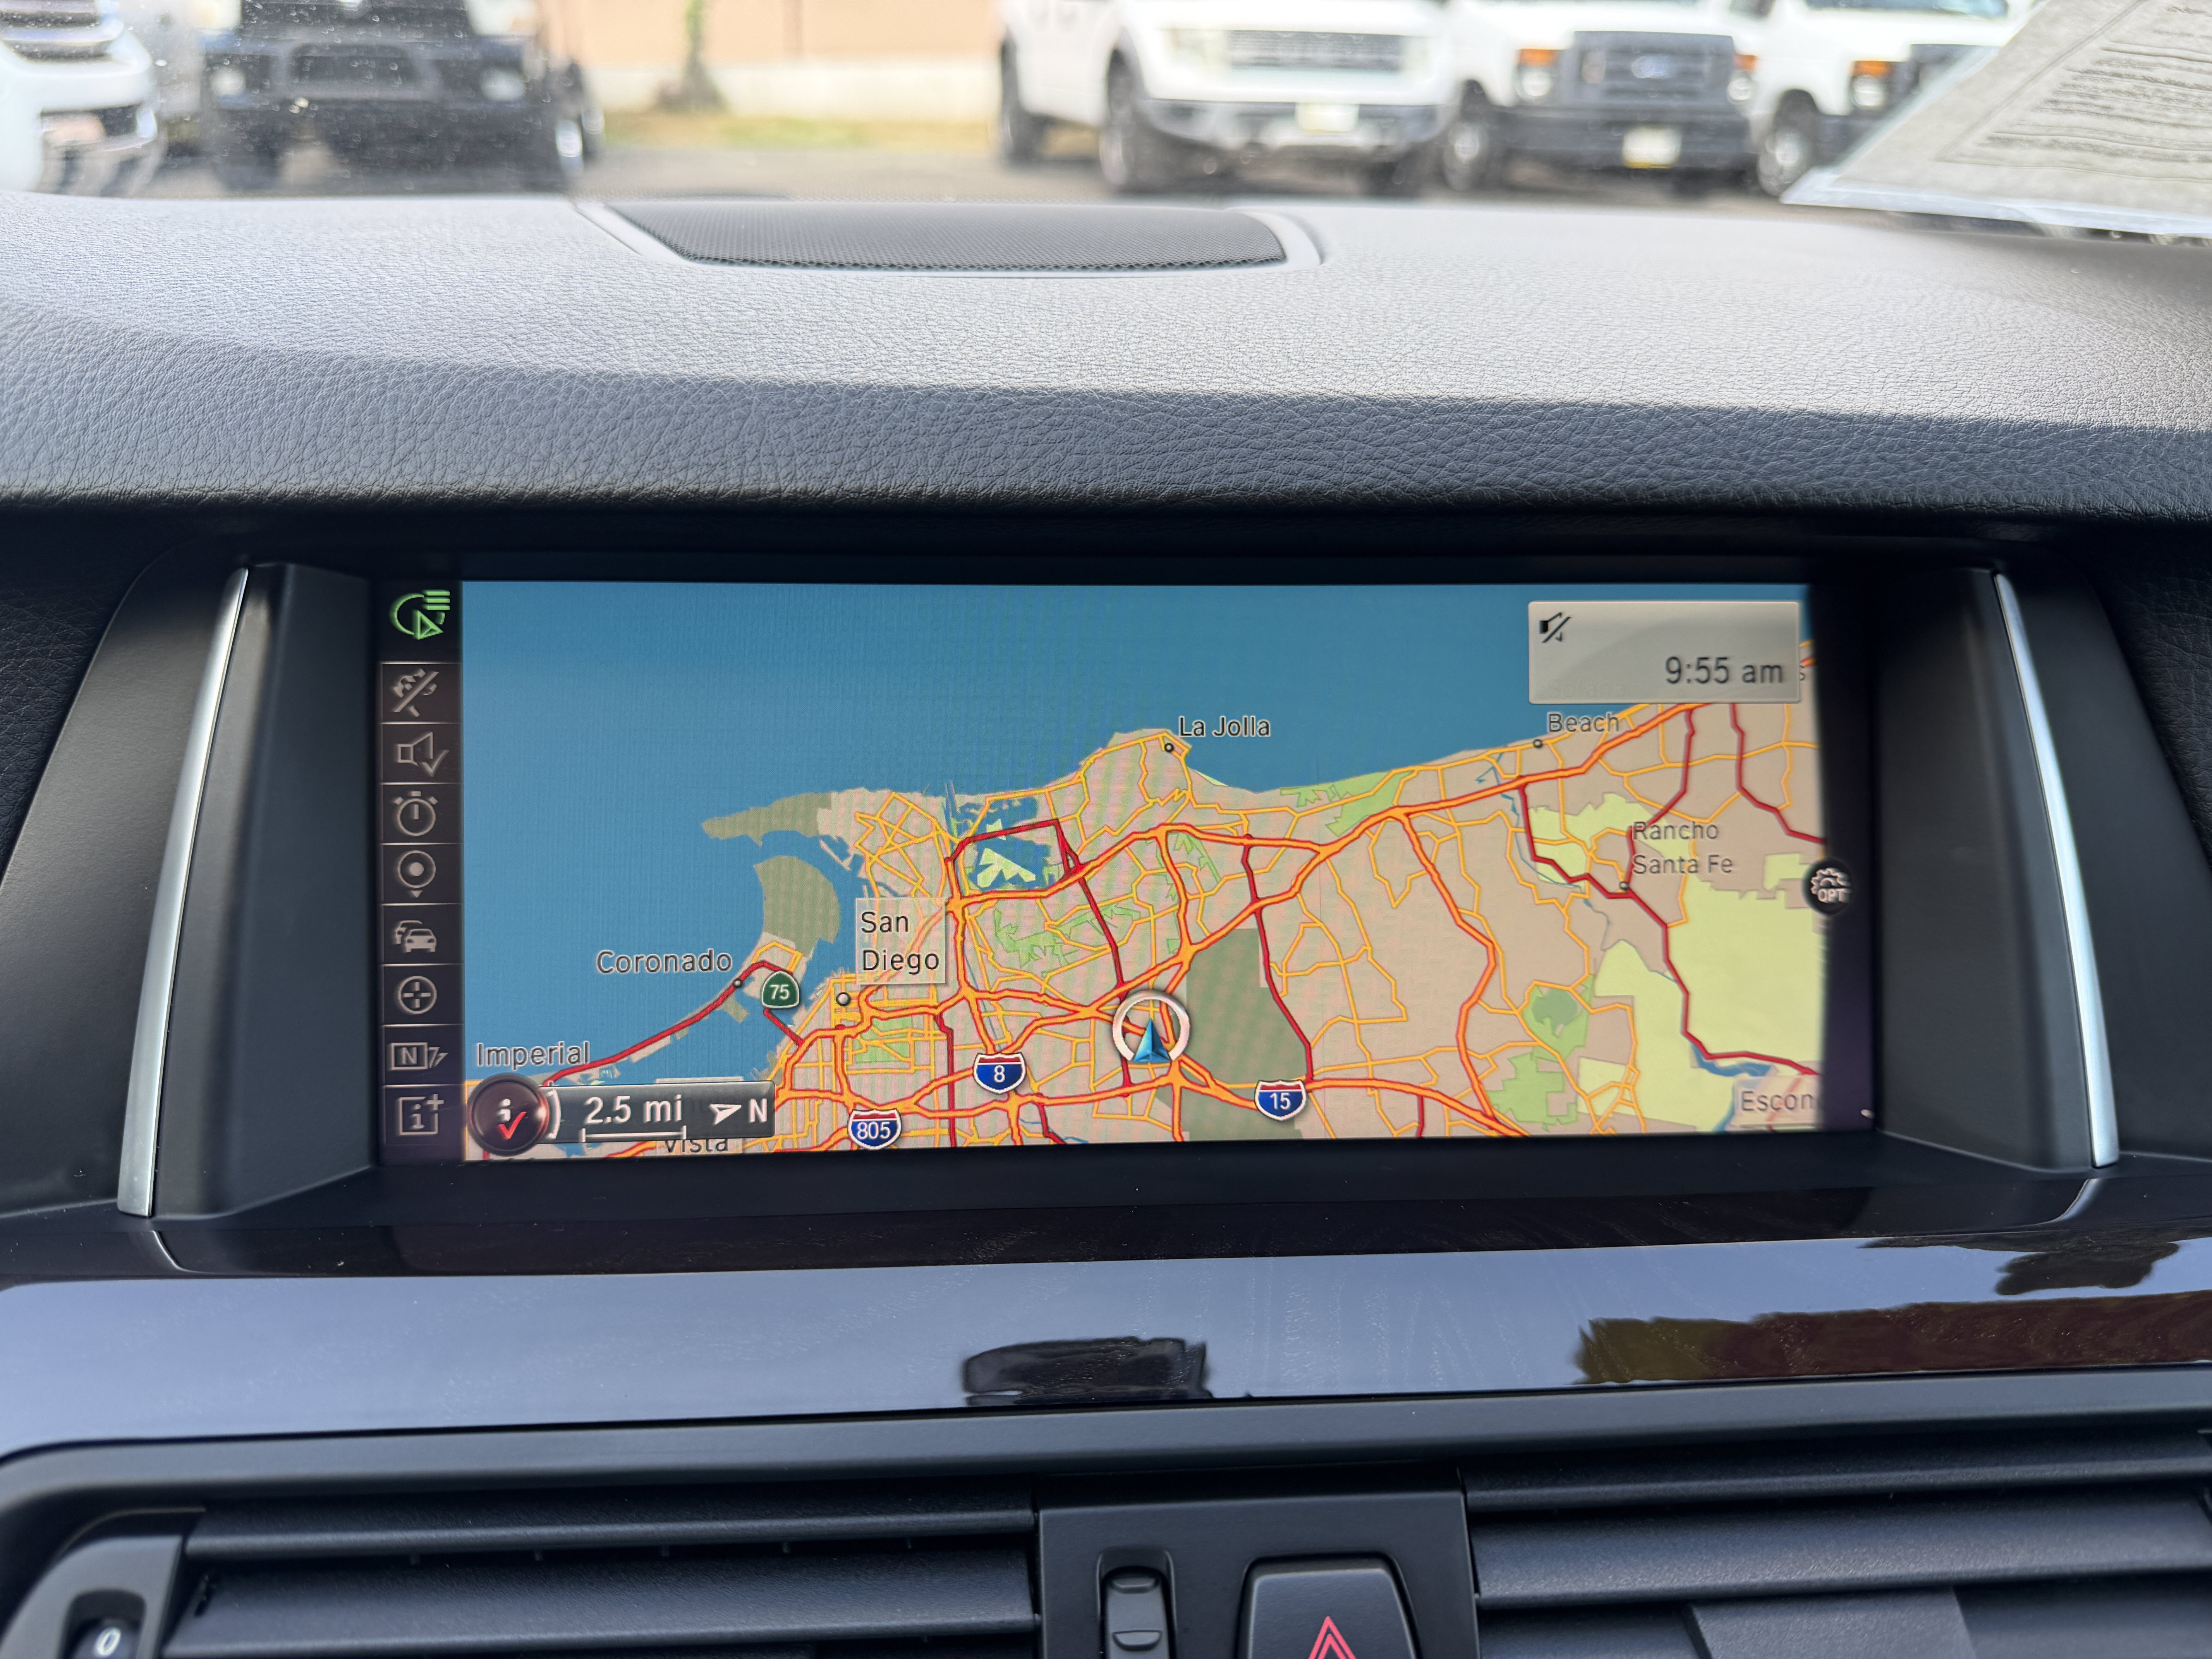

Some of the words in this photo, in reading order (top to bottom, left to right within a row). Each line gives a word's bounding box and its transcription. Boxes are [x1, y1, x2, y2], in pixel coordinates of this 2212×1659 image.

[1665, 656, 1730, 685] 9:55
[1741, 662, 1784, 685] am
[1179, 716, 1205, 737] La
[1212, 716, 1271, 737] Jolla
[1548, 712, 1620, 732] Beach
[1632, 821, 1718, 840] Rancho
[1632, 854, 1699, 874] Santa
[1708, 854, 1733, 873] Fe
[1818, 888, 1851, 903] OPT
[861, 911, 909, 933] San
[596, 949, 732, 974] Coronado
[863, 950, 939, 975] Diego
[769, 984, 790, 1001] 75
[476, 1041, 589, 1070] Imperial
[994, 1065, 1005, 1083] 8
[585, 1096, 631, 1124] 2.5
[643, 1094, 683, 1123] mi
[749, 1099, 767, 1123] N
[1269, 1093, 1290, 1110] 15
[857, 1122, 891, 1140] 805
